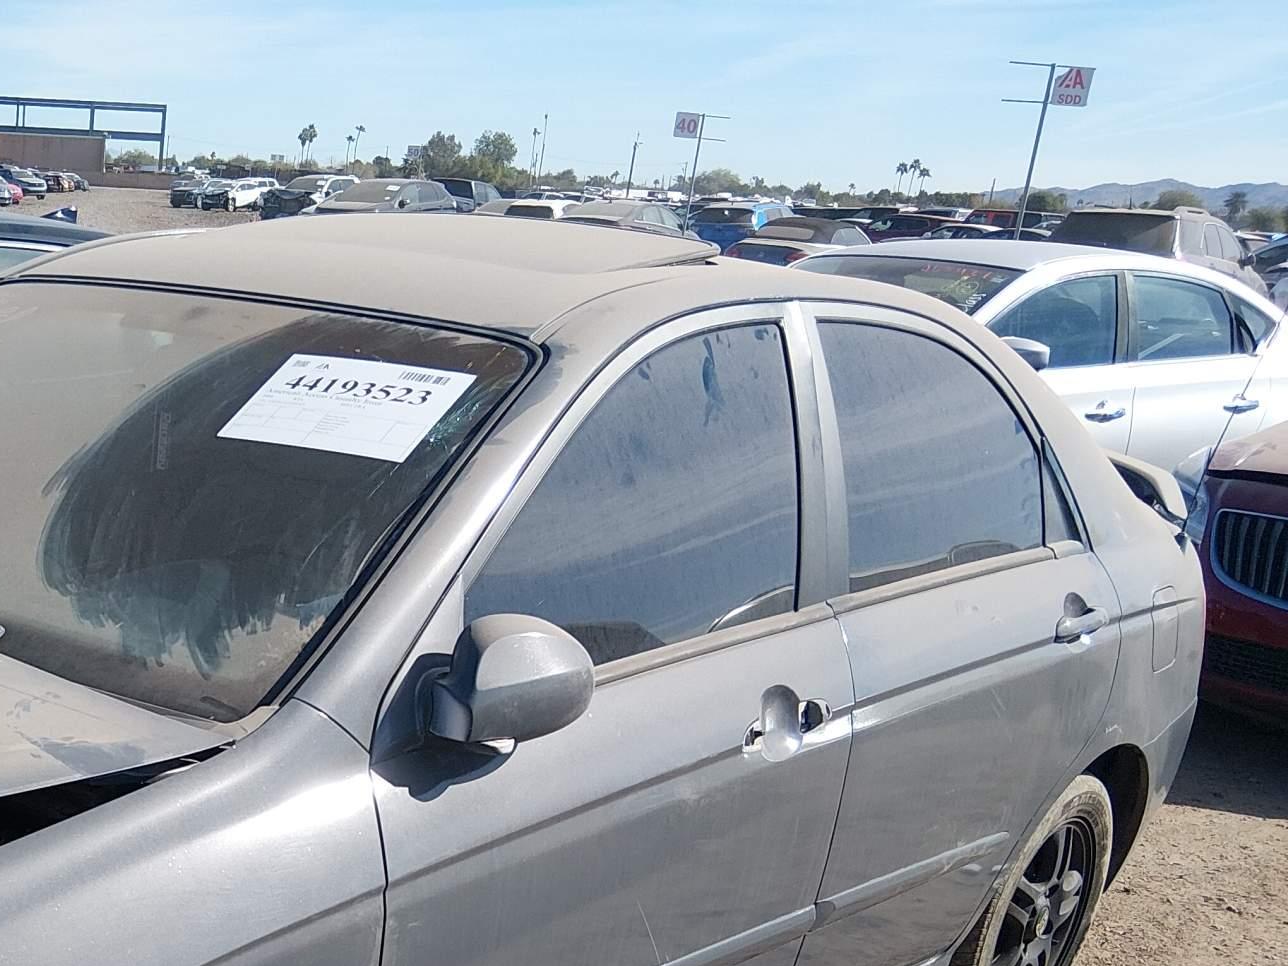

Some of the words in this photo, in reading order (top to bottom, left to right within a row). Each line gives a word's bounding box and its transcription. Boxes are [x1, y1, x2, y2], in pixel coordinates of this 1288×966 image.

[1057, 94, 1082, 105] SDD
[676, 118, 697, 134] 40
[284, 374, 433, 406] 44193523
